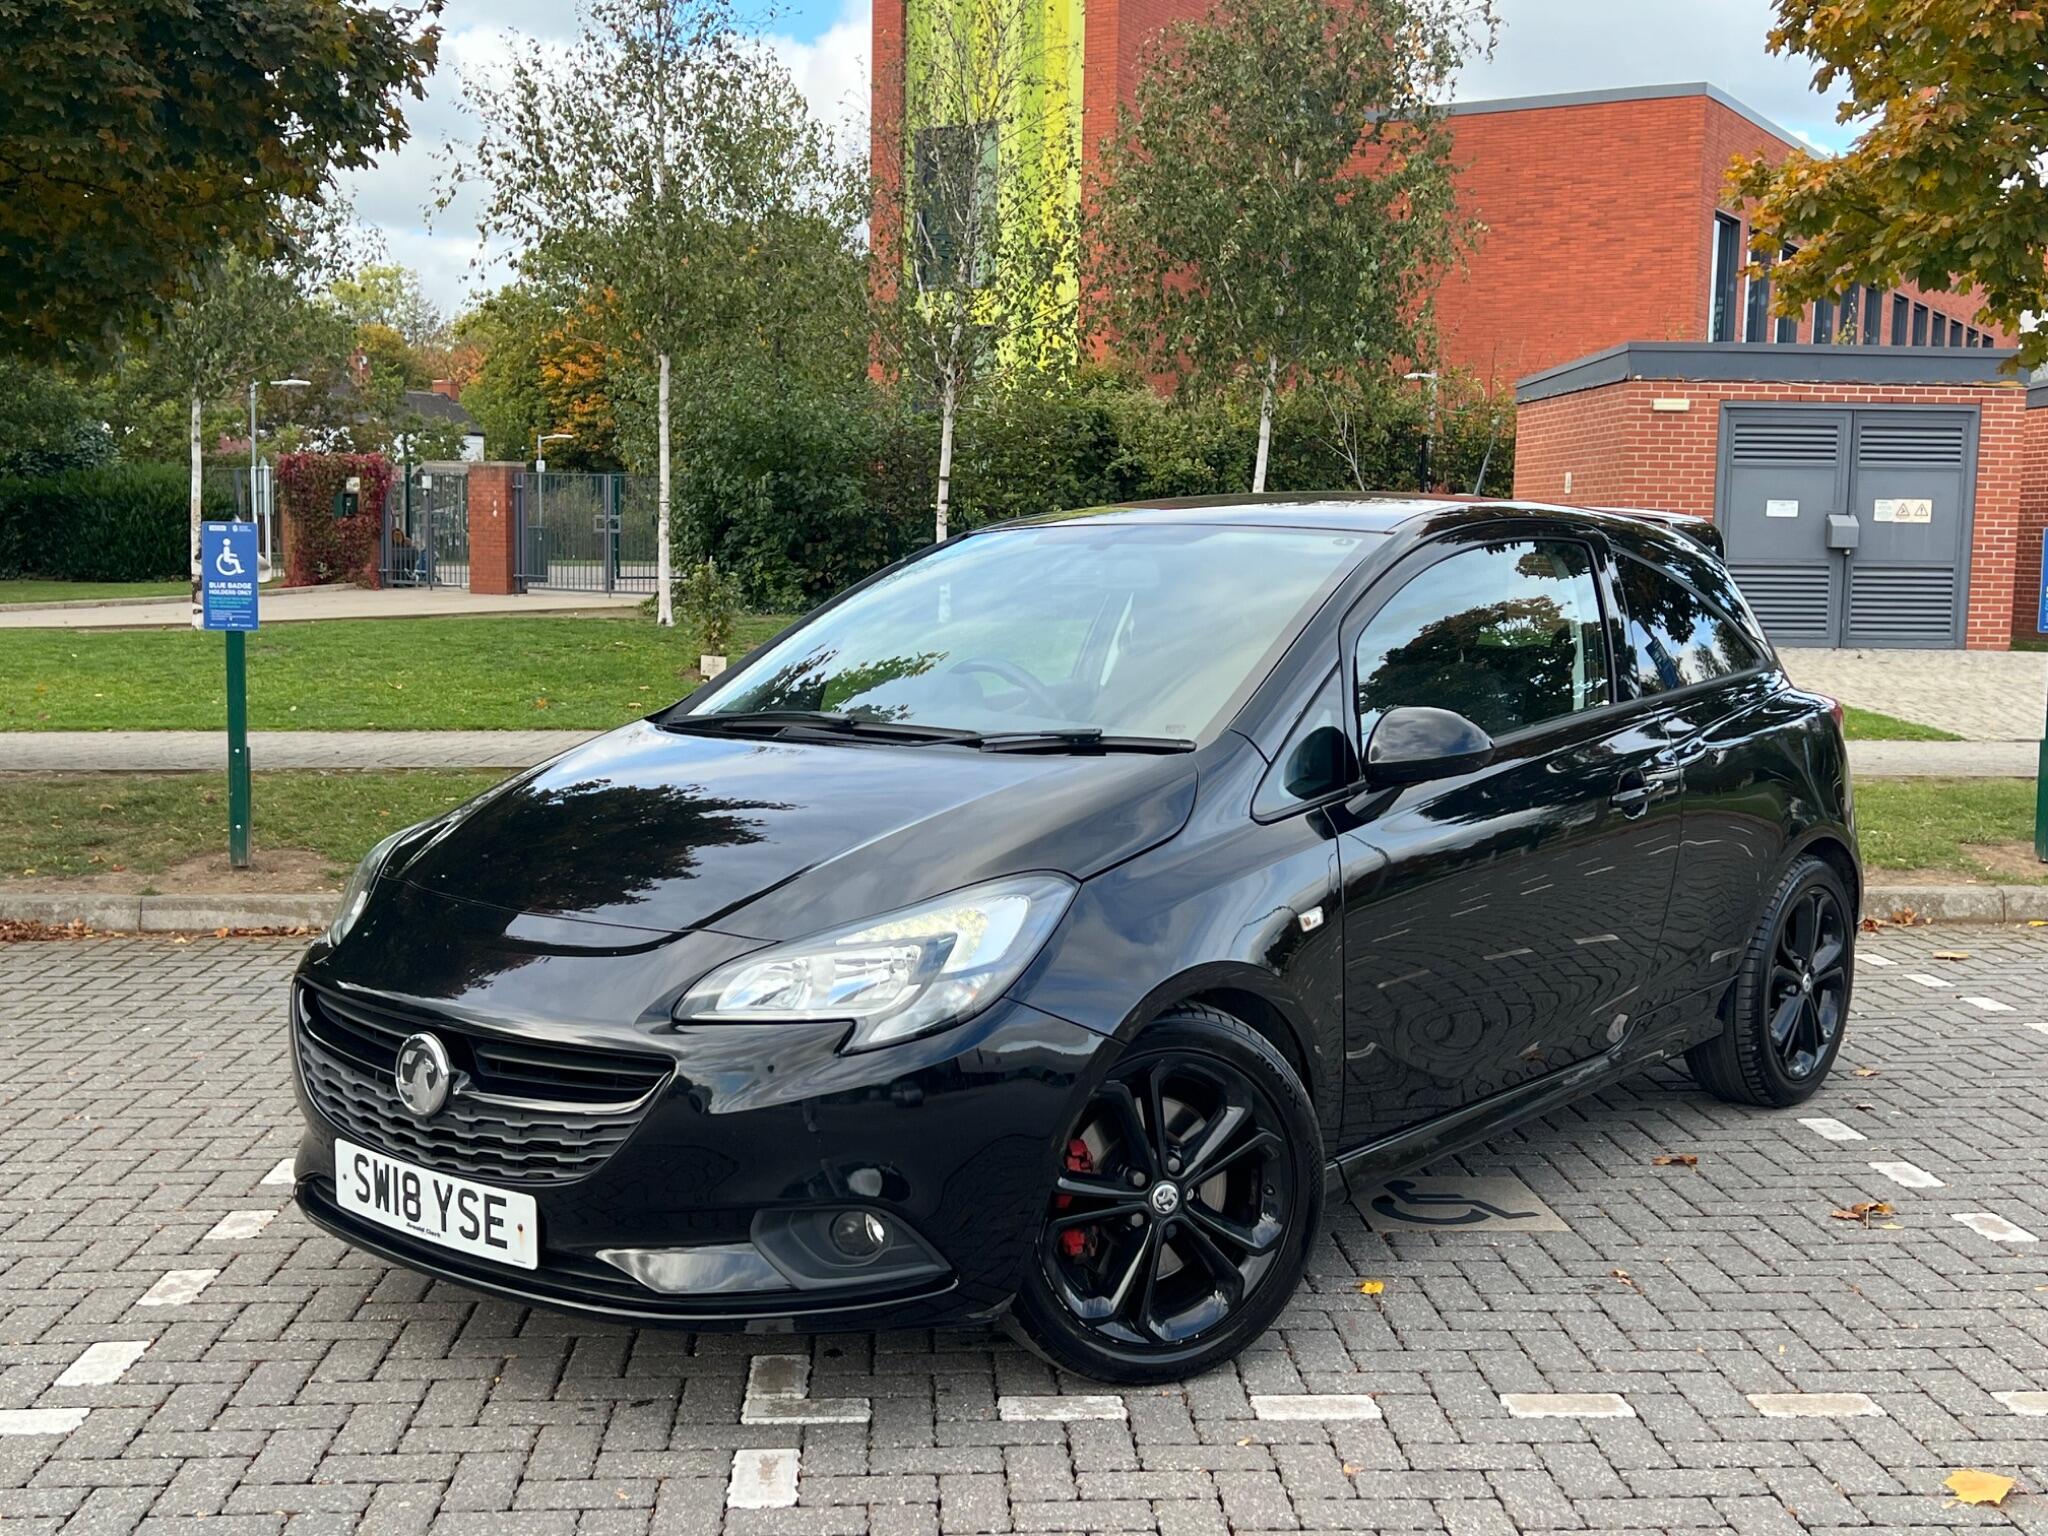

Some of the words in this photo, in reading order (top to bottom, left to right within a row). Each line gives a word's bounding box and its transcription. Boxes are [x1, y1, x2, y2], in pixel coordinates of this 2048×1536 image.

[227, 582, 252, 590] BADGE
[354, 1153, 421, 1222] SW18
[433, 1179, 508, 1249] YSE
